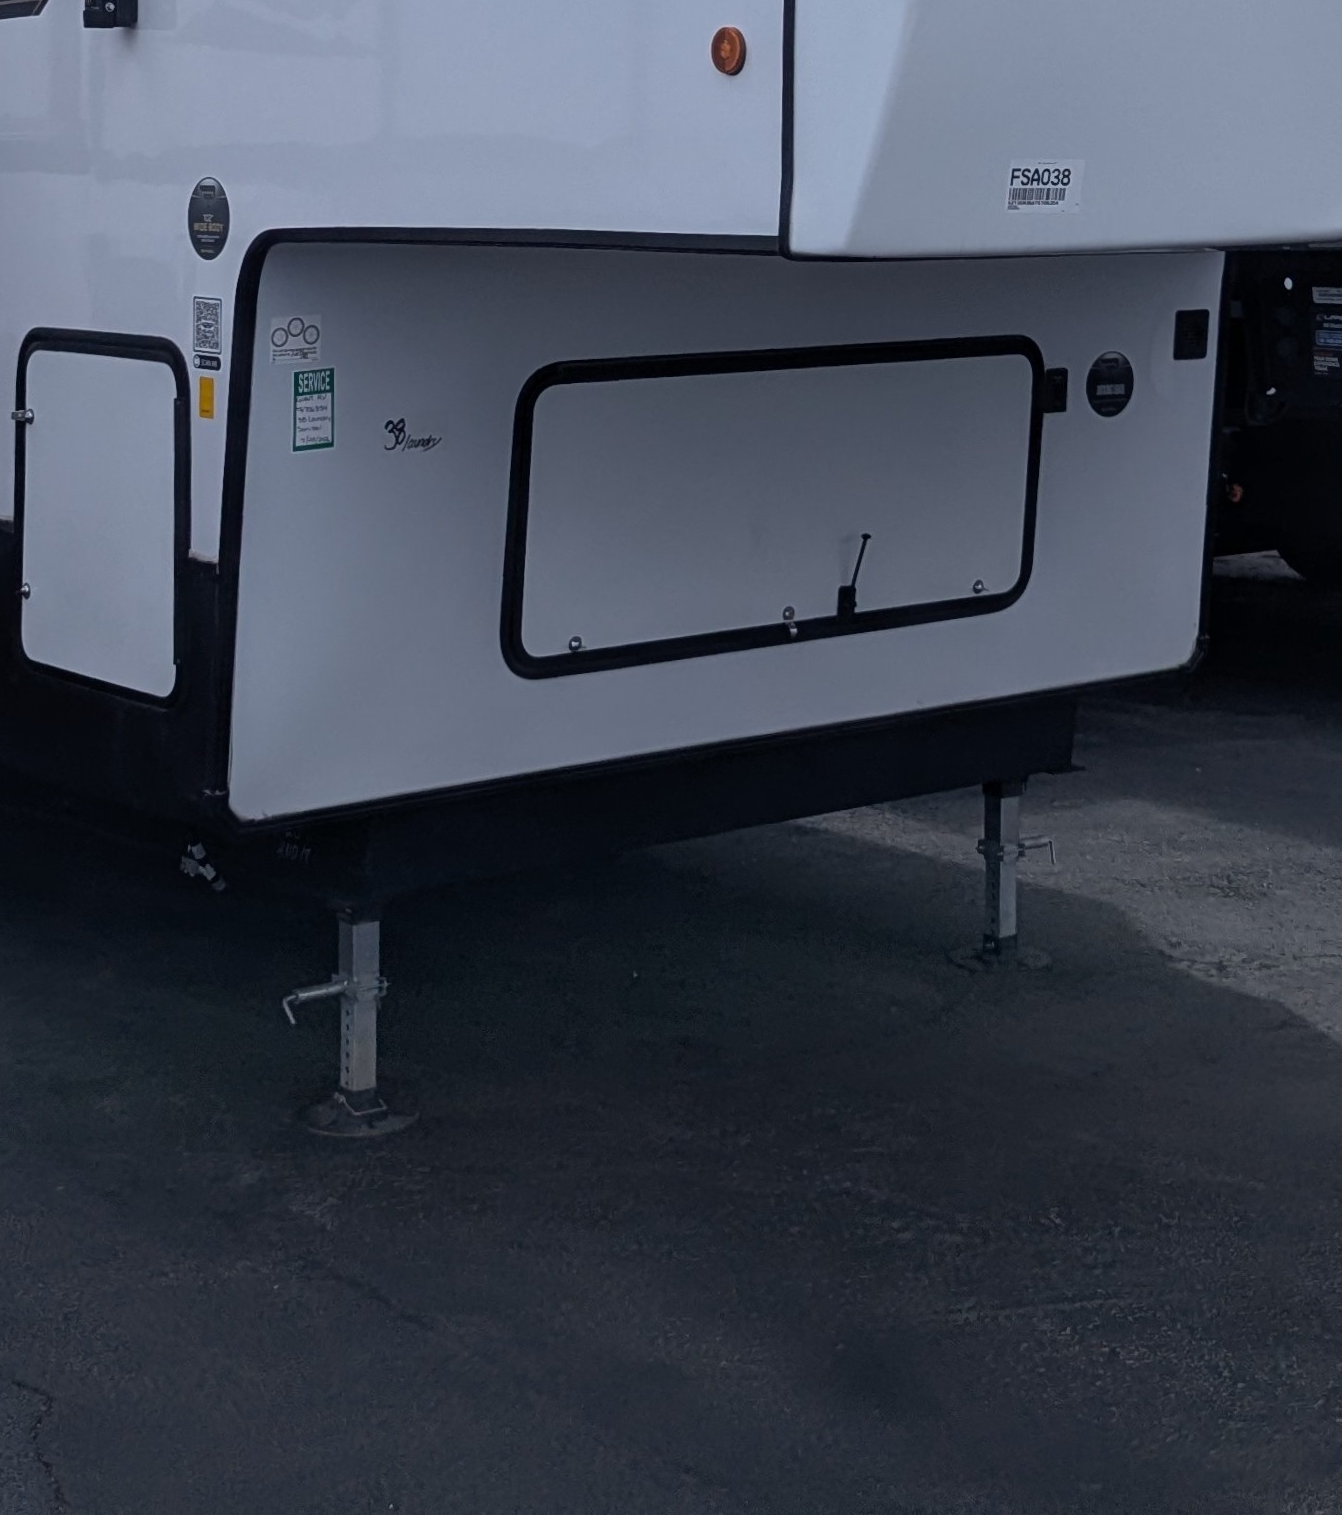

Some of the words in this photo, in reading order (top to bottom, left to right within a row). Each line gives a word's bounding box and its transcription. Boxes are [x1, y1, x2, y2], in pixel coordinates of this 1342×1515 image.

[1009, 167, 1072, 187] FSA038
[298, 370, 331, 394] SERVICE
[384, 417, 407, 451] 38
